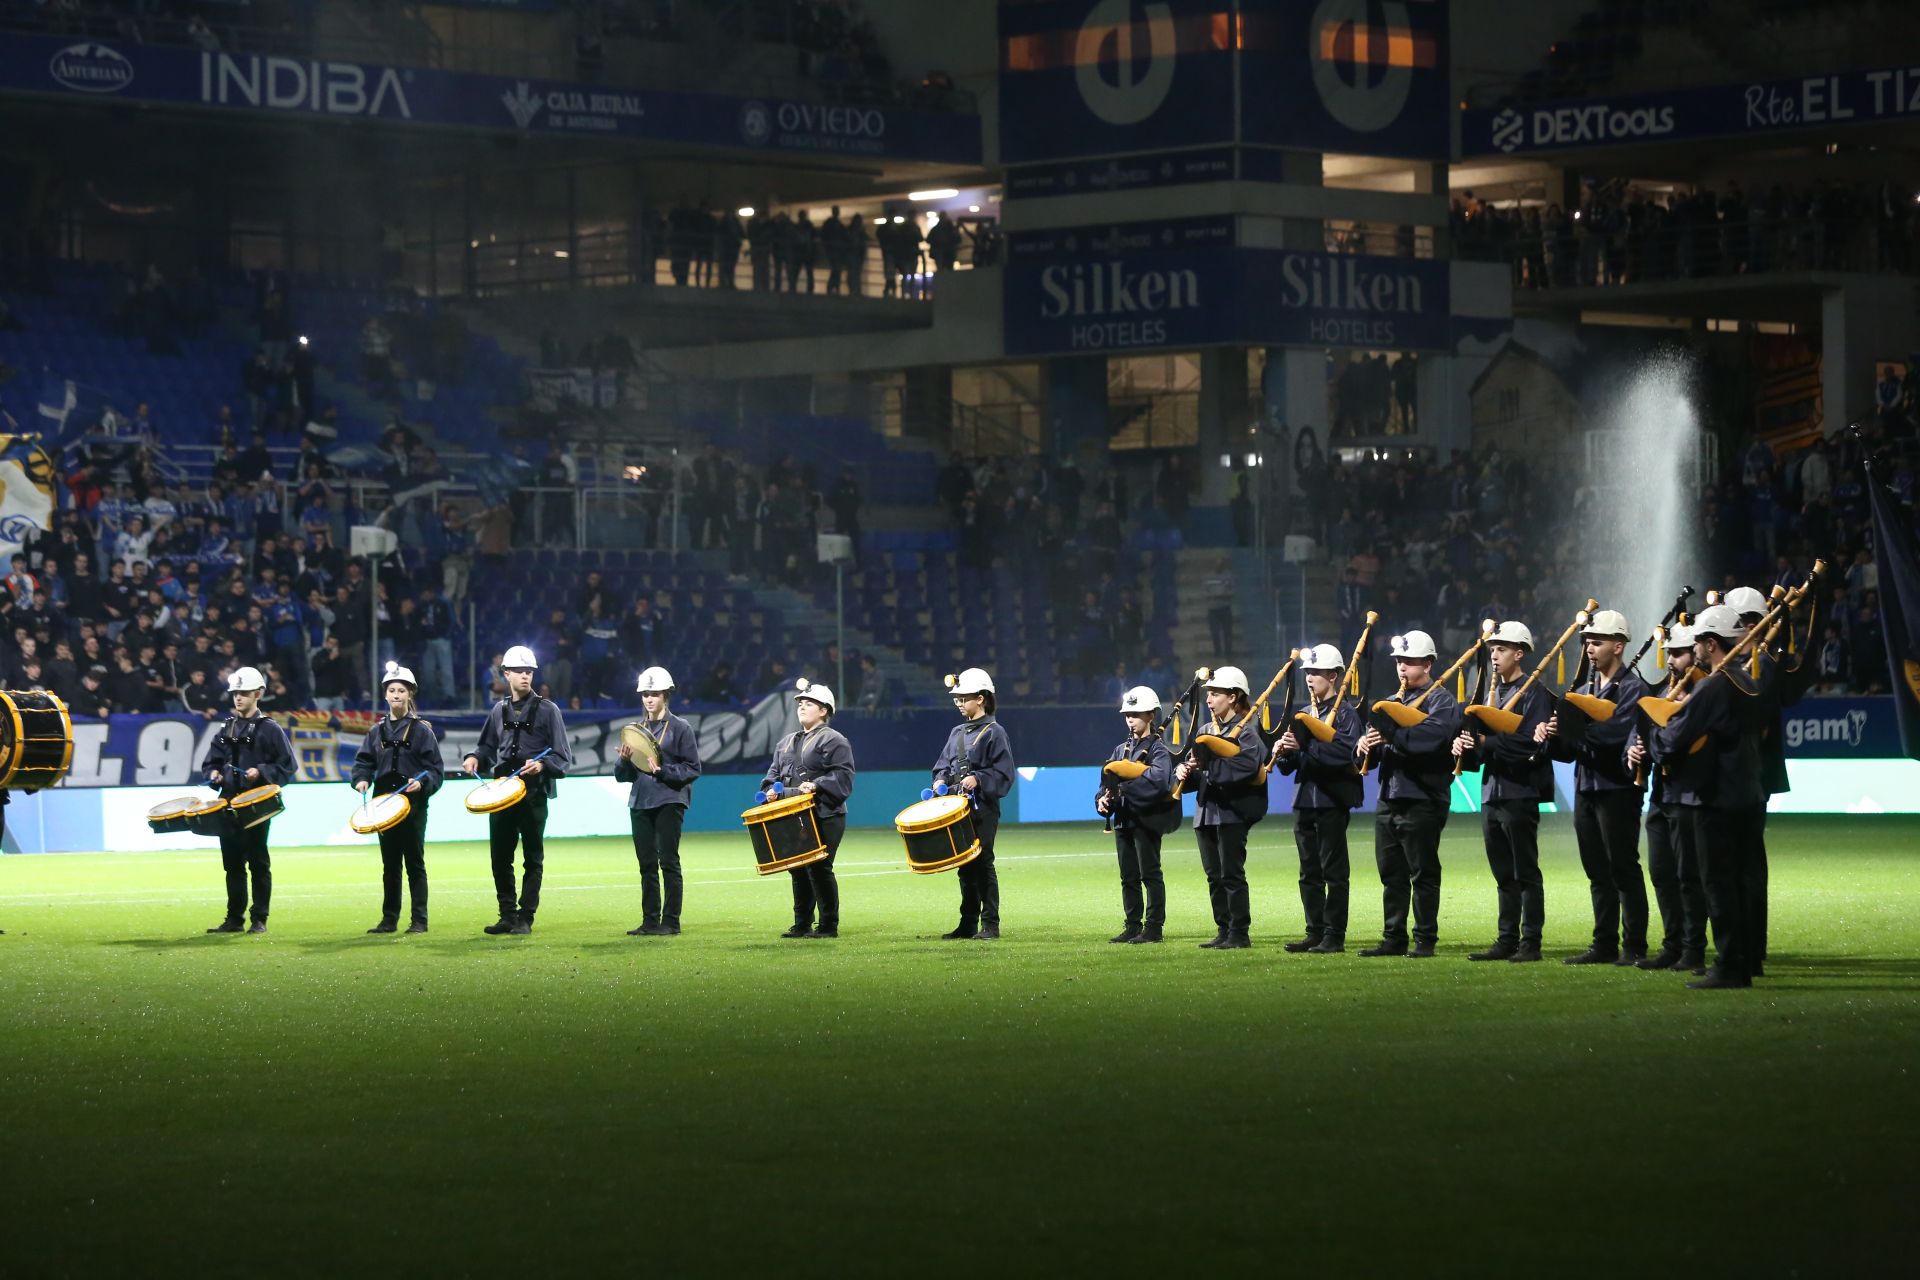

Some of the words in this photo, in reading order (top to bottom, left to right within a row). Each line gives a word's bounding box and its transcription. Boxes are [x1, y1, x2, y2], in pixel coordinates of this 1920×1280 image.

[201, 52, 411, 118] INDIBA
[1802, 76, 1855, 122] EL
[590, 93, 645, 117] RURAL
[777, 102, 885, 138] OVIEDO
[1040, 259, 1200, 319] Silken
[1281, 254, 1422, 315] Silken
[1071, 320, 1167, 349] HOTELES
[1310, 318, 1395, 346] HOTELES
[1785, 718, 1850, 748] gam
